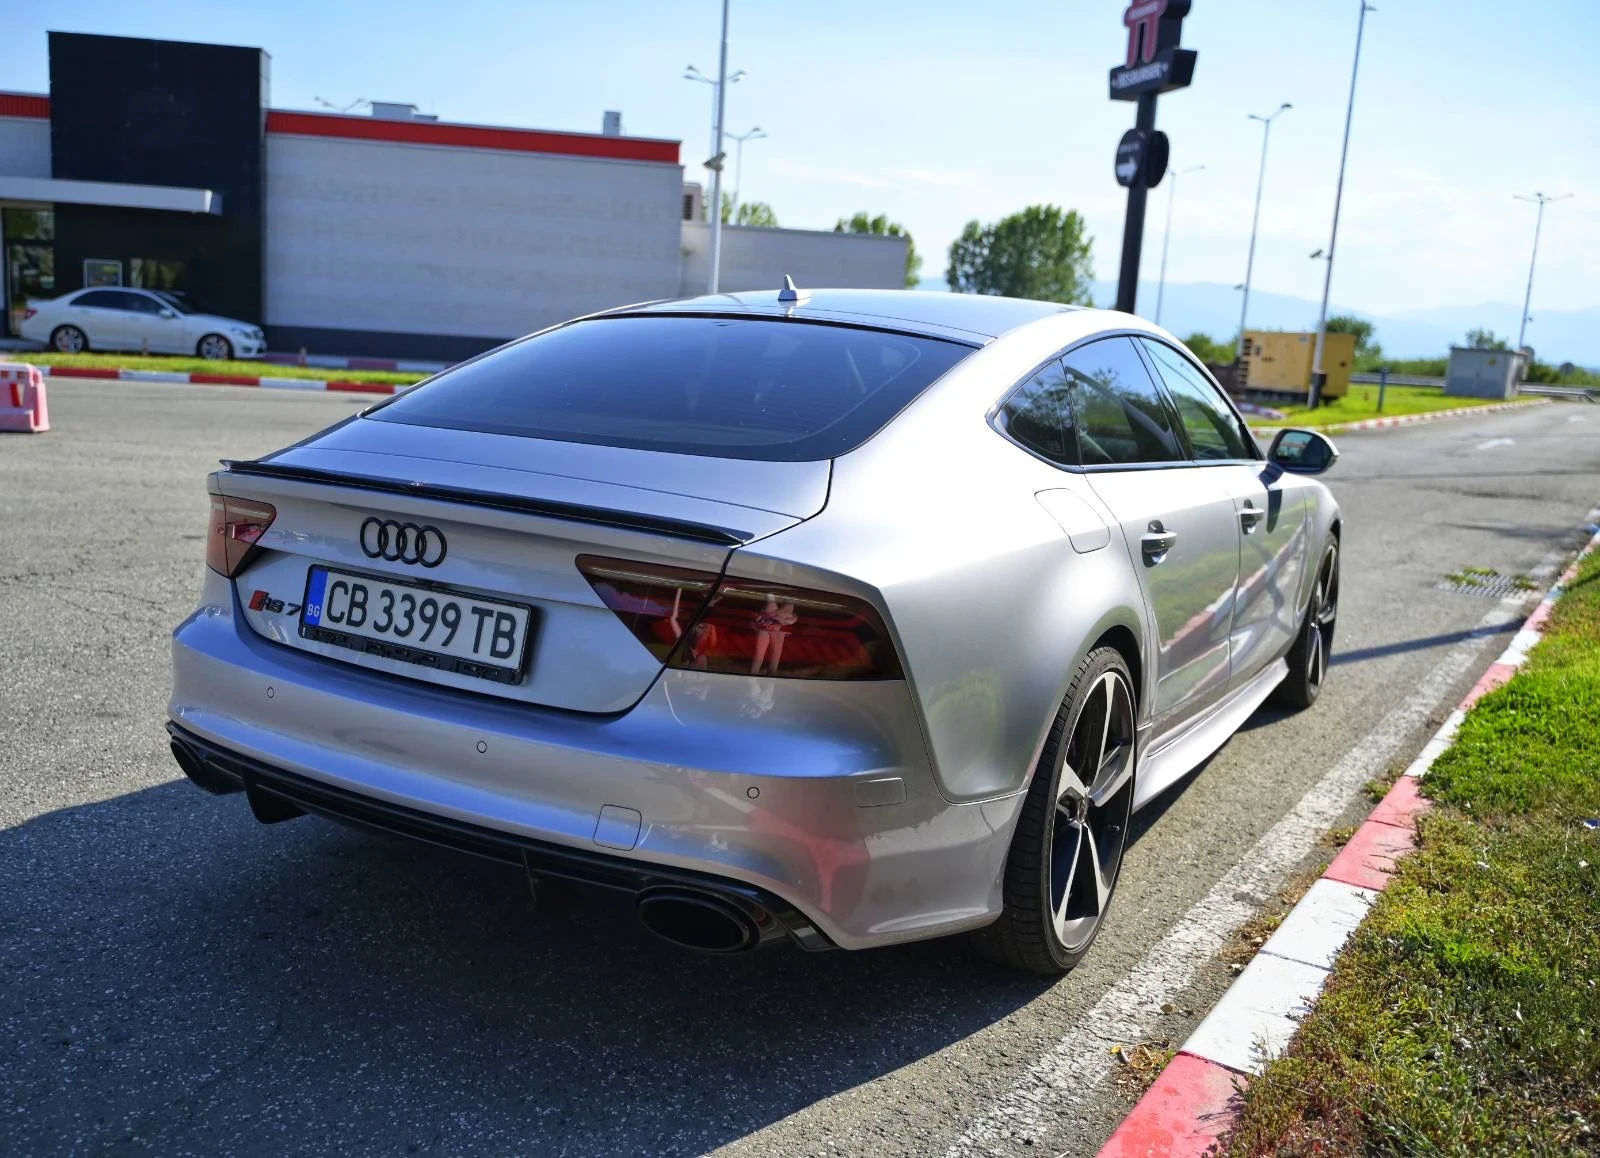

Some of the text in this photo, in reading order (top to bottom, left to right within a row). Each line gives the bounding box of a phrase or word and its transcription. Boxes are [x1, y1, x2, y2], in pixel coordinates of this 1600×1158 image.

[307, 603, 321, 618] BG
[326, 580, 518, 659] CB 3399 TB
